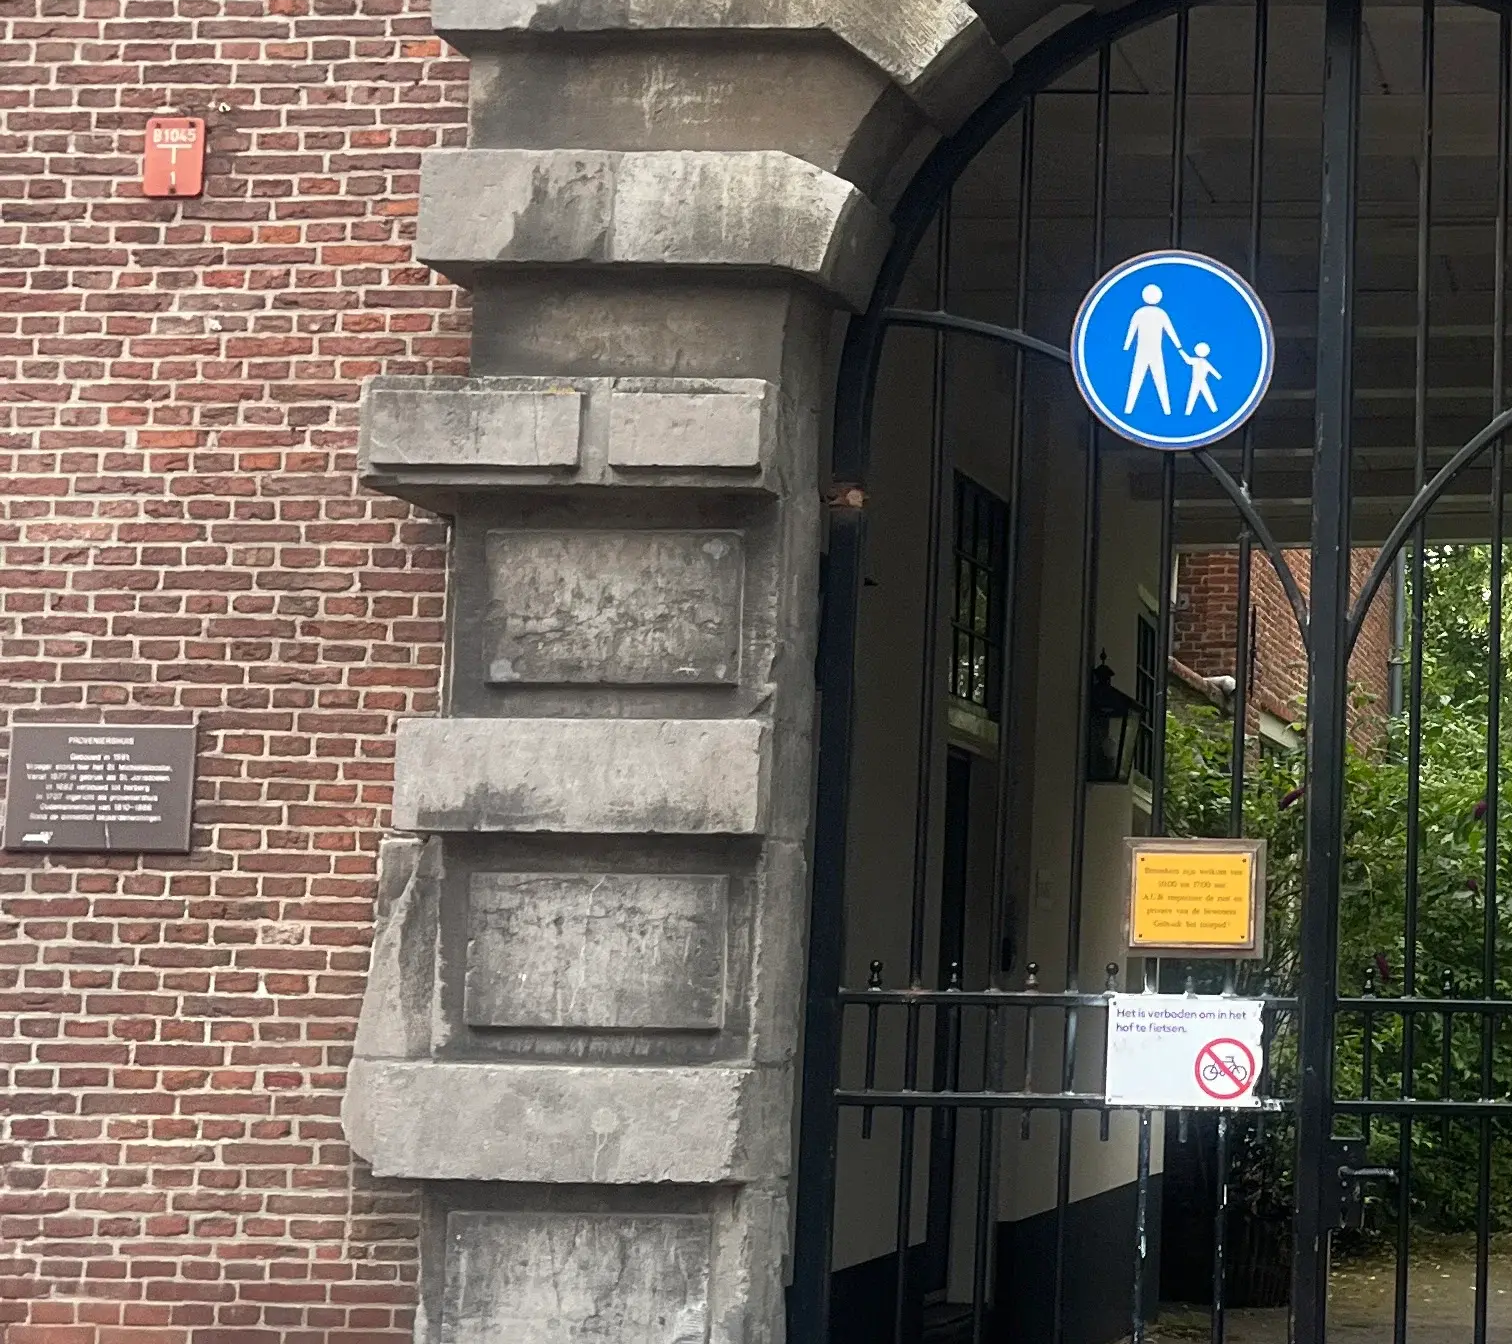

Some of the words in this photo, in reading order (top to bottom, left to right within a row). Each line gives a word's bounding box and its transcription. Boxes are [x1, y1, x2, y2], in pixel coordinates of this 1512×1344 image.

[1116, 1008, 1136, 1018] Het
[1138, 1009, 1146, 1018] is
[1148, 1008, 1197, 1019] verboden
[1199, 1011, 1216, 1019] om
[1218, 1010, 1228, 1019] in
[1229, 1009, 1246, 1019] het
[1116, 1023, 1134, 1032] hof
[1136, 1023, 1146, 1033] te
